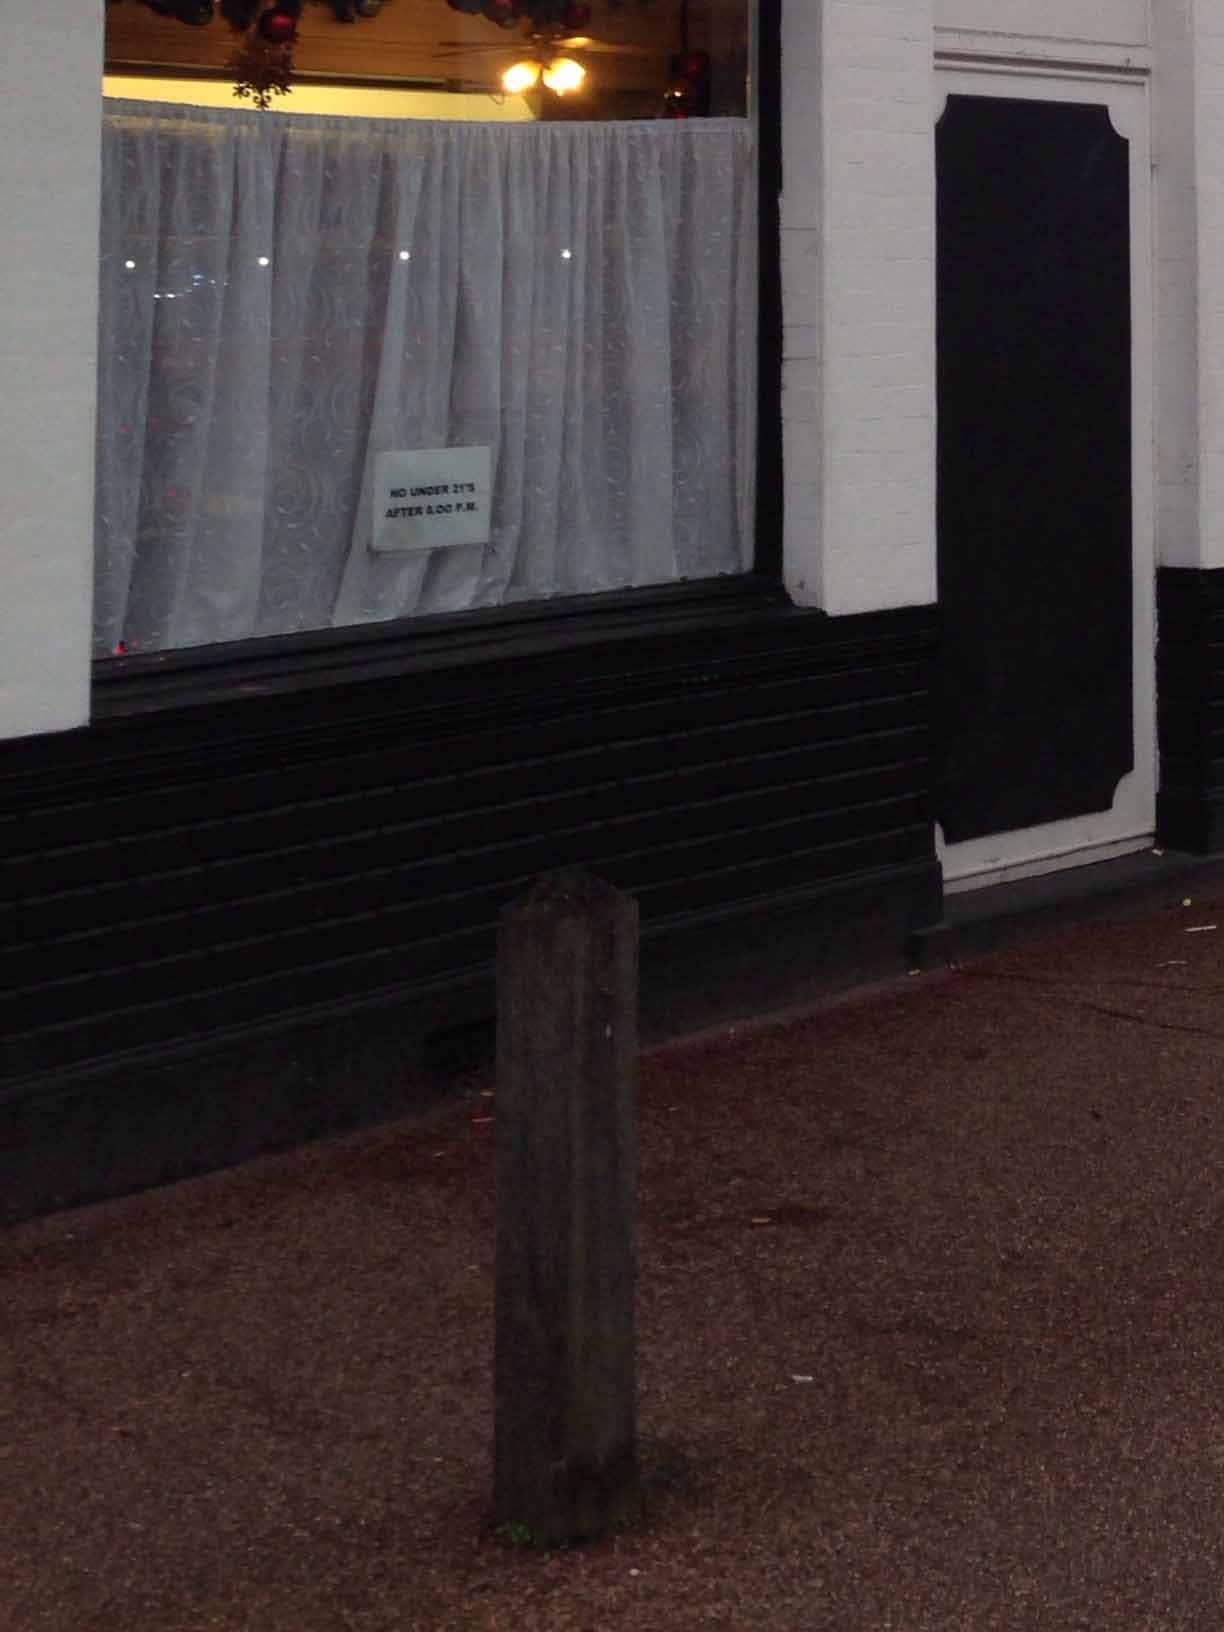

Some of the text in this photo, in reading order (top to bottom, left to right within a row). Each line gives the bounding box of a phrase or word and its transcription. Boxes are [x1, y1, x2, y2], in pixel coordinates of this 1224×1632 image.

[390, 488, 407, 498] NO
[410, 485, 449, 497] UNDER
[385, 506, 423, 518] AFTER
